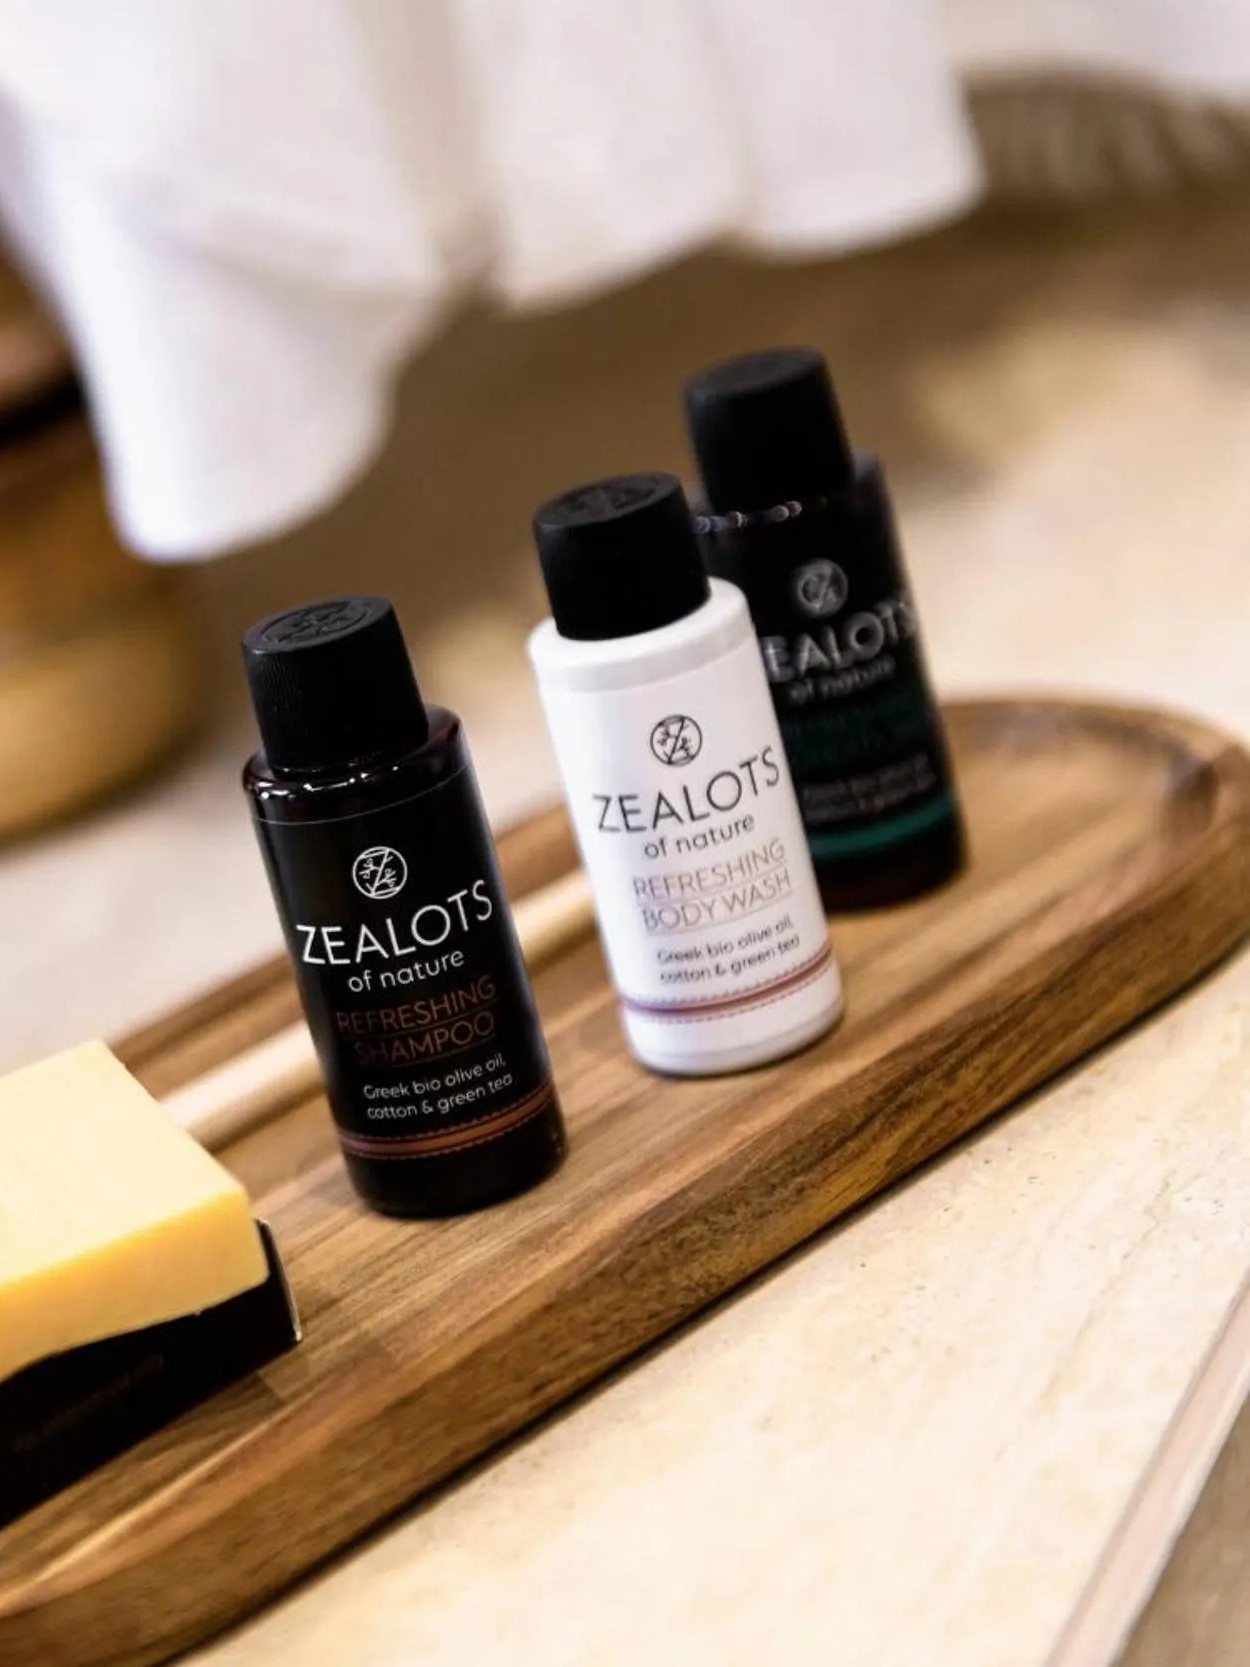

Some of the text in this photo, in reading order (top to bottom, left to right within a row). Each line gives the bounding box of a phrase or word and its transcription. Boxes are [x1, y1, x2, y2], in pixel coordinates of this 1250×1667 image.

[758, 592, 918, 682] EALOT
[592, 745, 780, 833] ZEALOTS
[644, 815, 755, 860] of nature
[633, 838, 786, 899] REFRESHING
[296, 879, 493, 965] ZEALOTS
[641, 868, 792, 931] BODY WASH
[347, 950, 465, 992] of nature
[656, 943, 703, 965] Greek
[706, 941, 734, 958] bio
[737, 926, 773, 949] olive
[660, 964, 712, 985] cotton
[730, 946, 777, 974] green
[777, 934, 801, 955] tea
[336, 974, 496, 1034] REFRESHING
[354, 1010, 495, 1065] SHAMPOO
[363, 1077, 410, 1100] Greek
[412, 1077, 441, 1096] bio
[445, 1064, 483, 1088] olive
[367, 1073, 513, 1120] cotton & green tea
